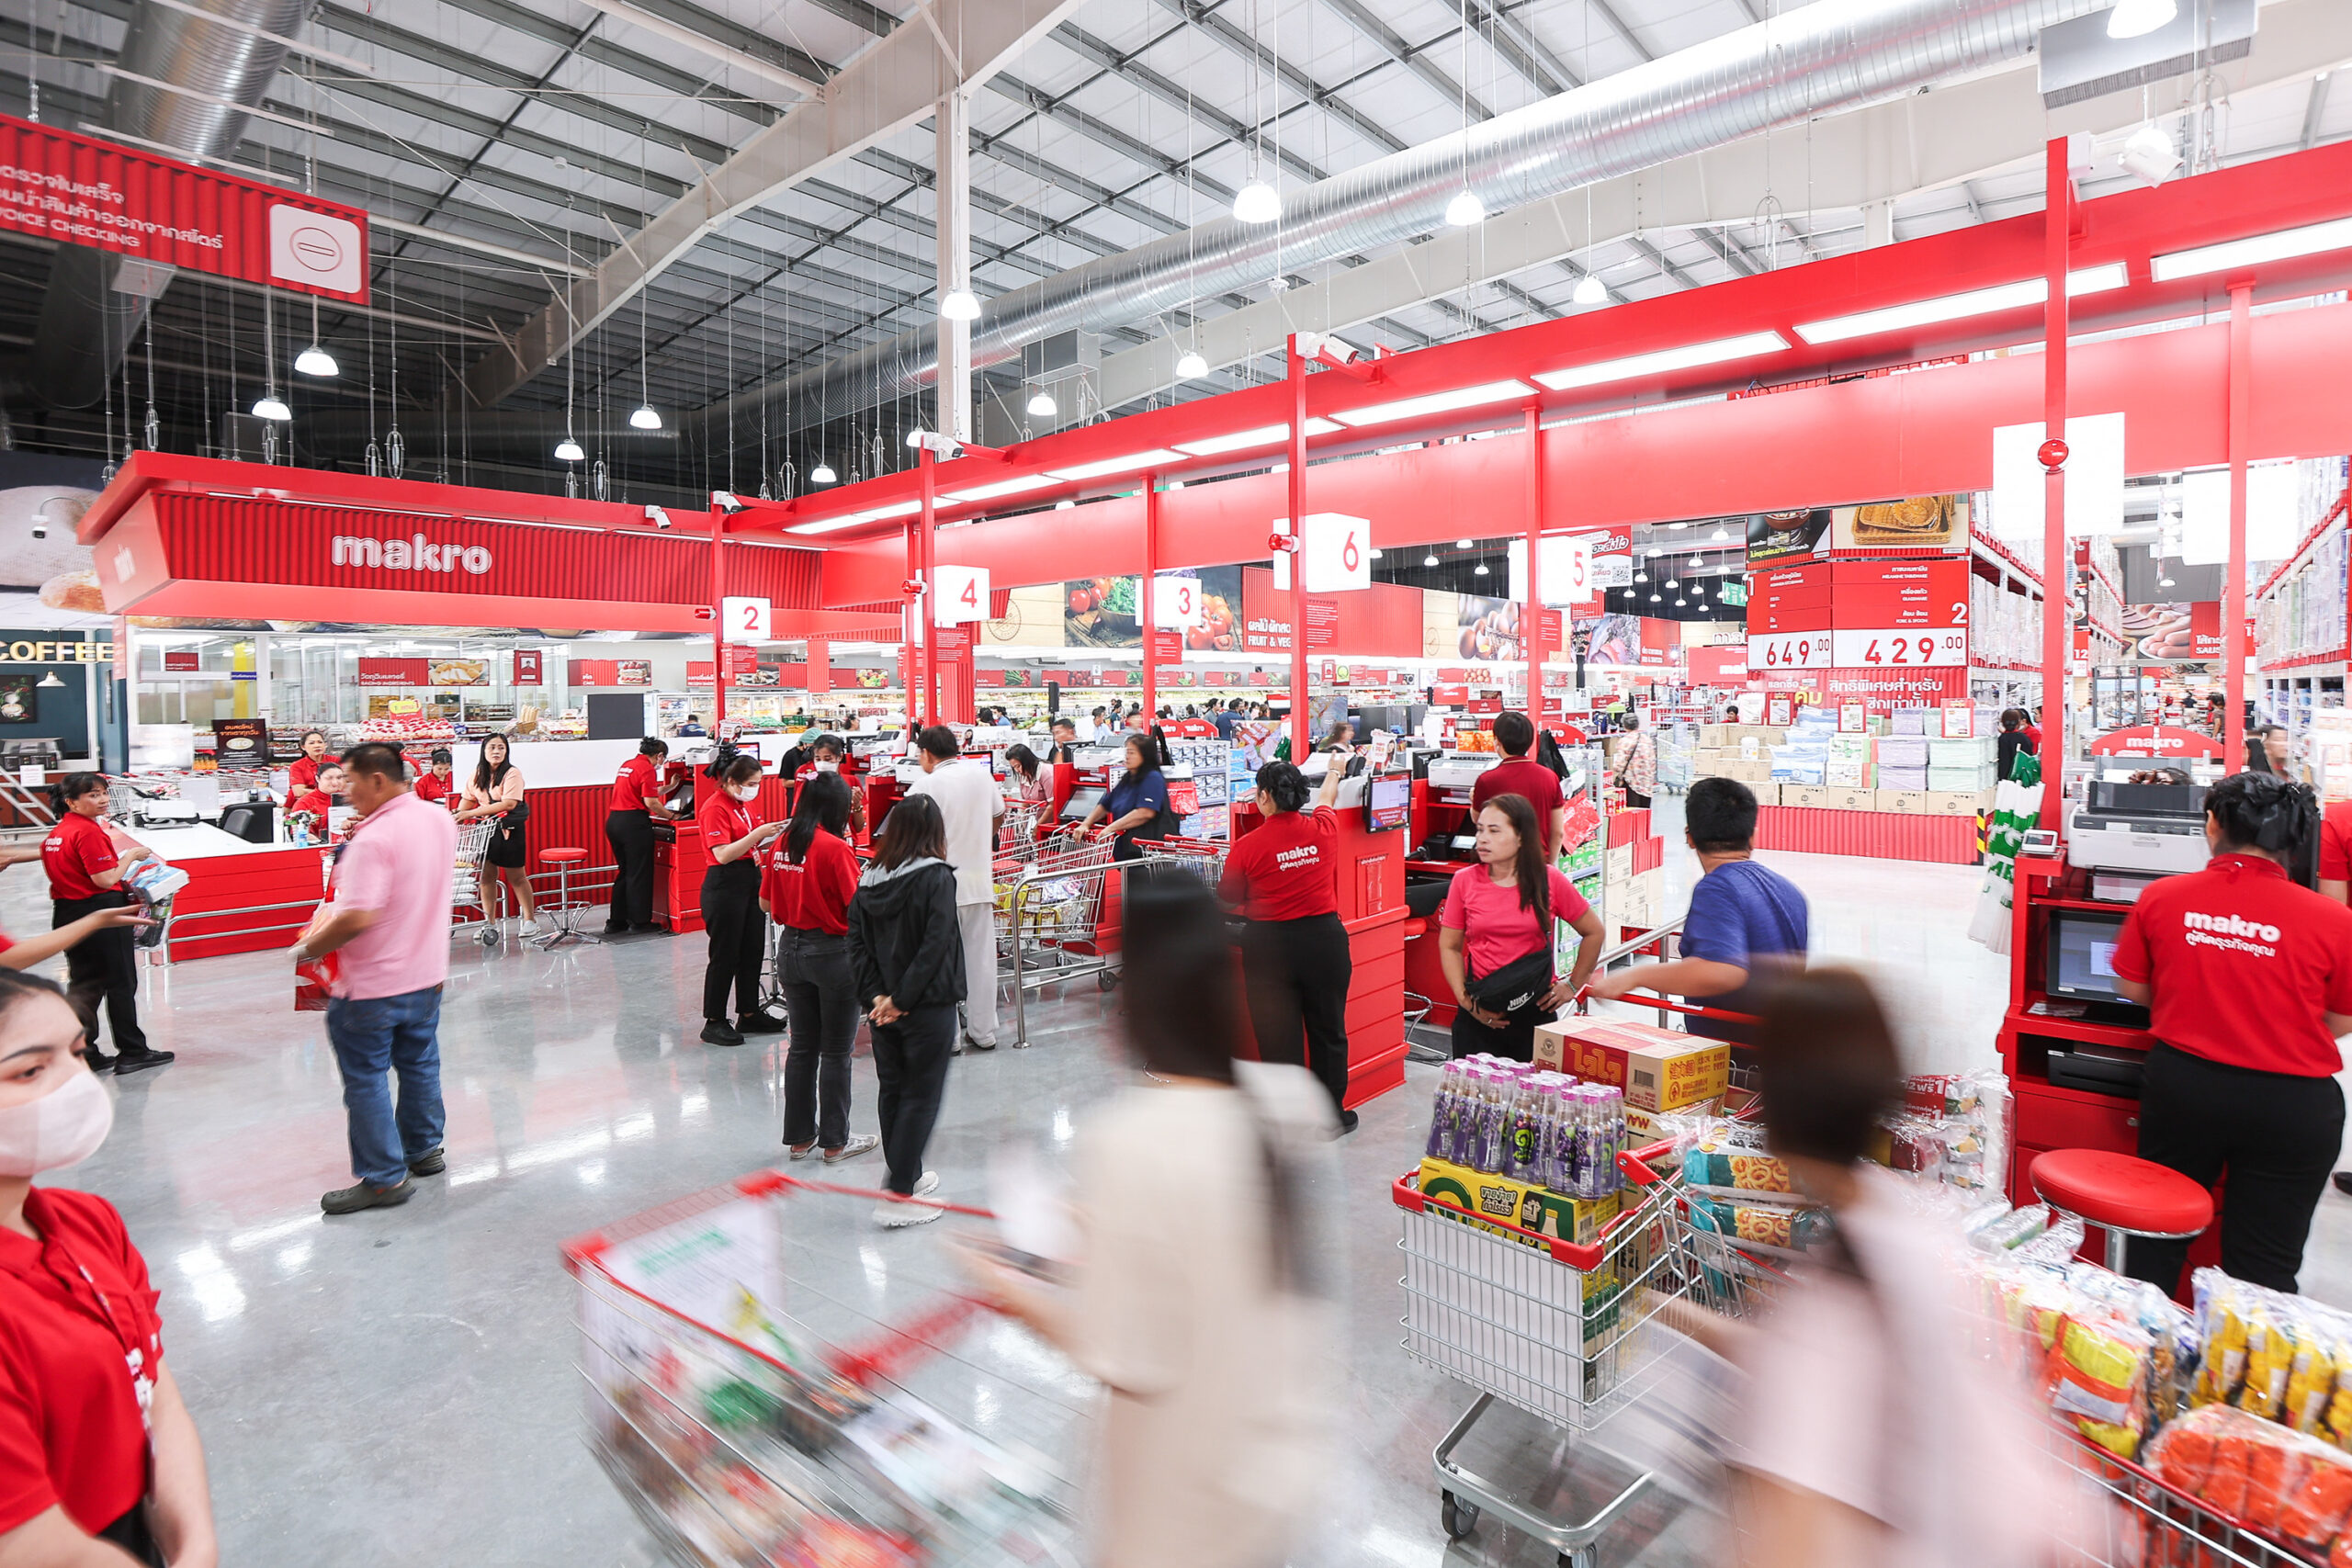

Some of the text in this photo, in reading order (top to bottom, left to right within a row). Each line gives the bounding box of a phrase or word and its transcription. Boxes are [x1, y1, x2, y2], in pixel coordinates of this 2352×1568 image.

[0, 165, 124, 204] ตรวจใบเสร็จ
[51, 219, 141, 247] CHECKING
[331, 533, 492, 575] makro
[1343, 531, 1359, 572] 6
[1573, 551, 1584, 587] 5
[960, 579, 978, 608] 4
[1748, 577, 1754, 596] 1
[1179, 587, 1191, 615] 3
[744, 606, 759, 630] 2
[1951, 603, 1968, 625] 2
[1248, 635, 1268, 647] FRUIT
[1269, 637, 1276, 648] &
[1767, 640, 1809, 666] 649
[1865, 637, 1935, 665] 429
[2196, 647, 2222, 655] SAUS
[1794, 686, 1823, 705] คุ้ม
[1828, 677, 1943, 693] สิทธิพิเศษสำหรับ
[1866, 692, 1931, 710] ชิกเท่านั้น
[1276, 844, 1318, 863] makro
[2183, 910, 2281, 943] makro
[1509, 992, 1529, 1008] NIKE
[1568, 1042, 1623, 1083] ไวไว
[1481, 1186, 1516, 1202] ขายง่าย!
[1483, 1199, 1512, 1215] กำไรเร็ว
